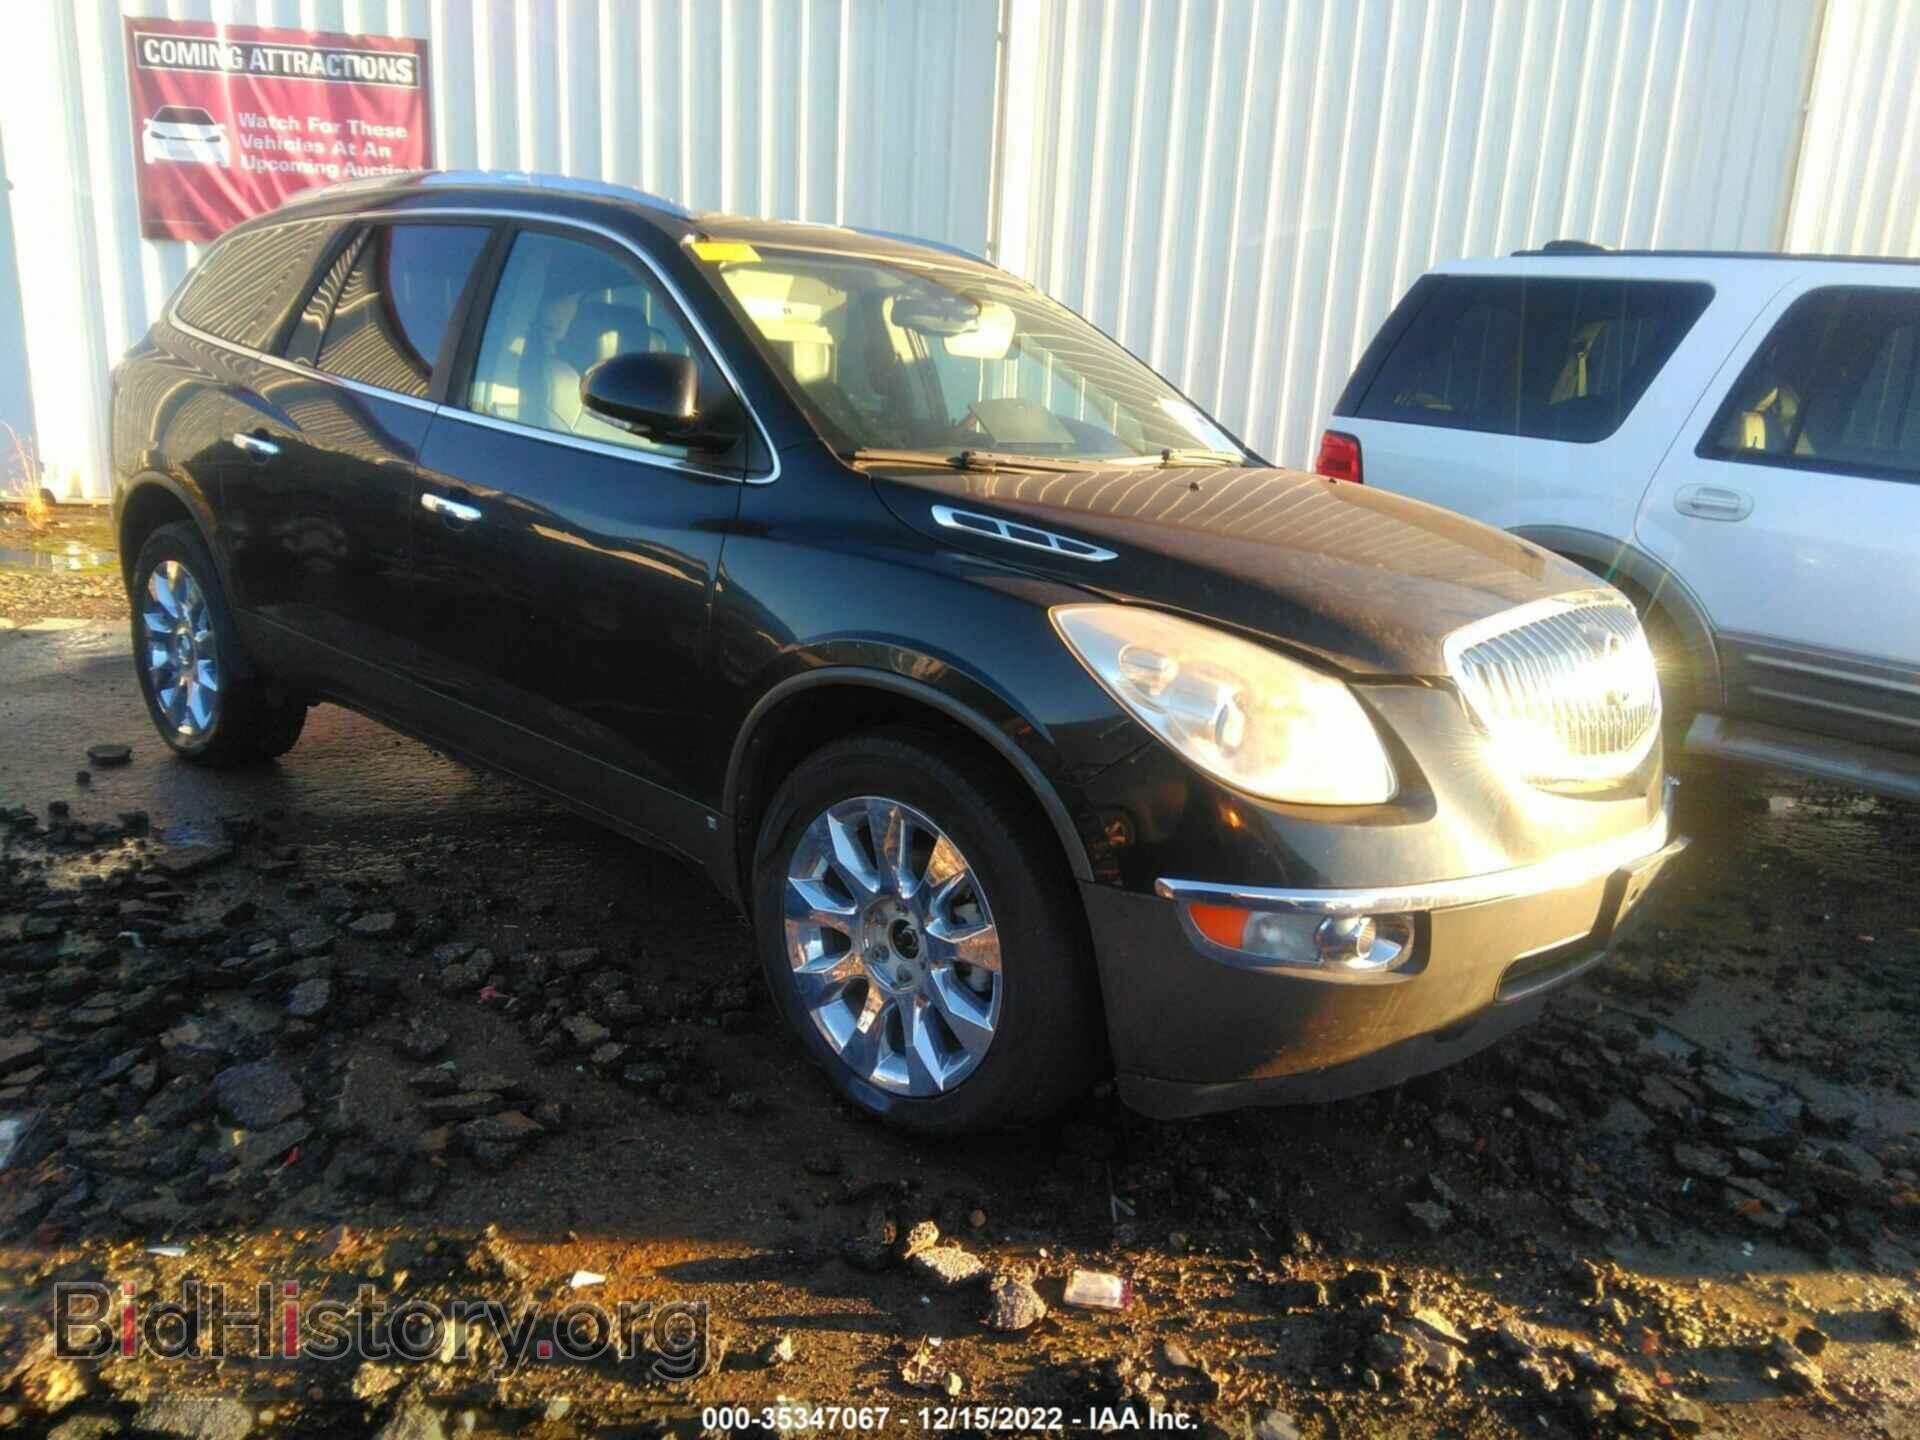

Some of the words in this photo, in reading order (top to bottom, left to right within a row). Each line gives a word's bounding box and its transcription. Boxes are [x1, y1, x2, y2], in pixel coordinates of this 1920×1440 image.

[143, 38, 243, 69] COMING
[249, 48, 413, 82] ATTRACTIONS
[239, 111, 299, 131] Watch
[307, 116, 341, 134] For
[348, 119, 408, 139] These
[239, 134, 325, 154] Vehicles
[333, 138, 357, 155] At
[363, 142, 392, 158] An
[239, 155, 338, 178] Upcoming
